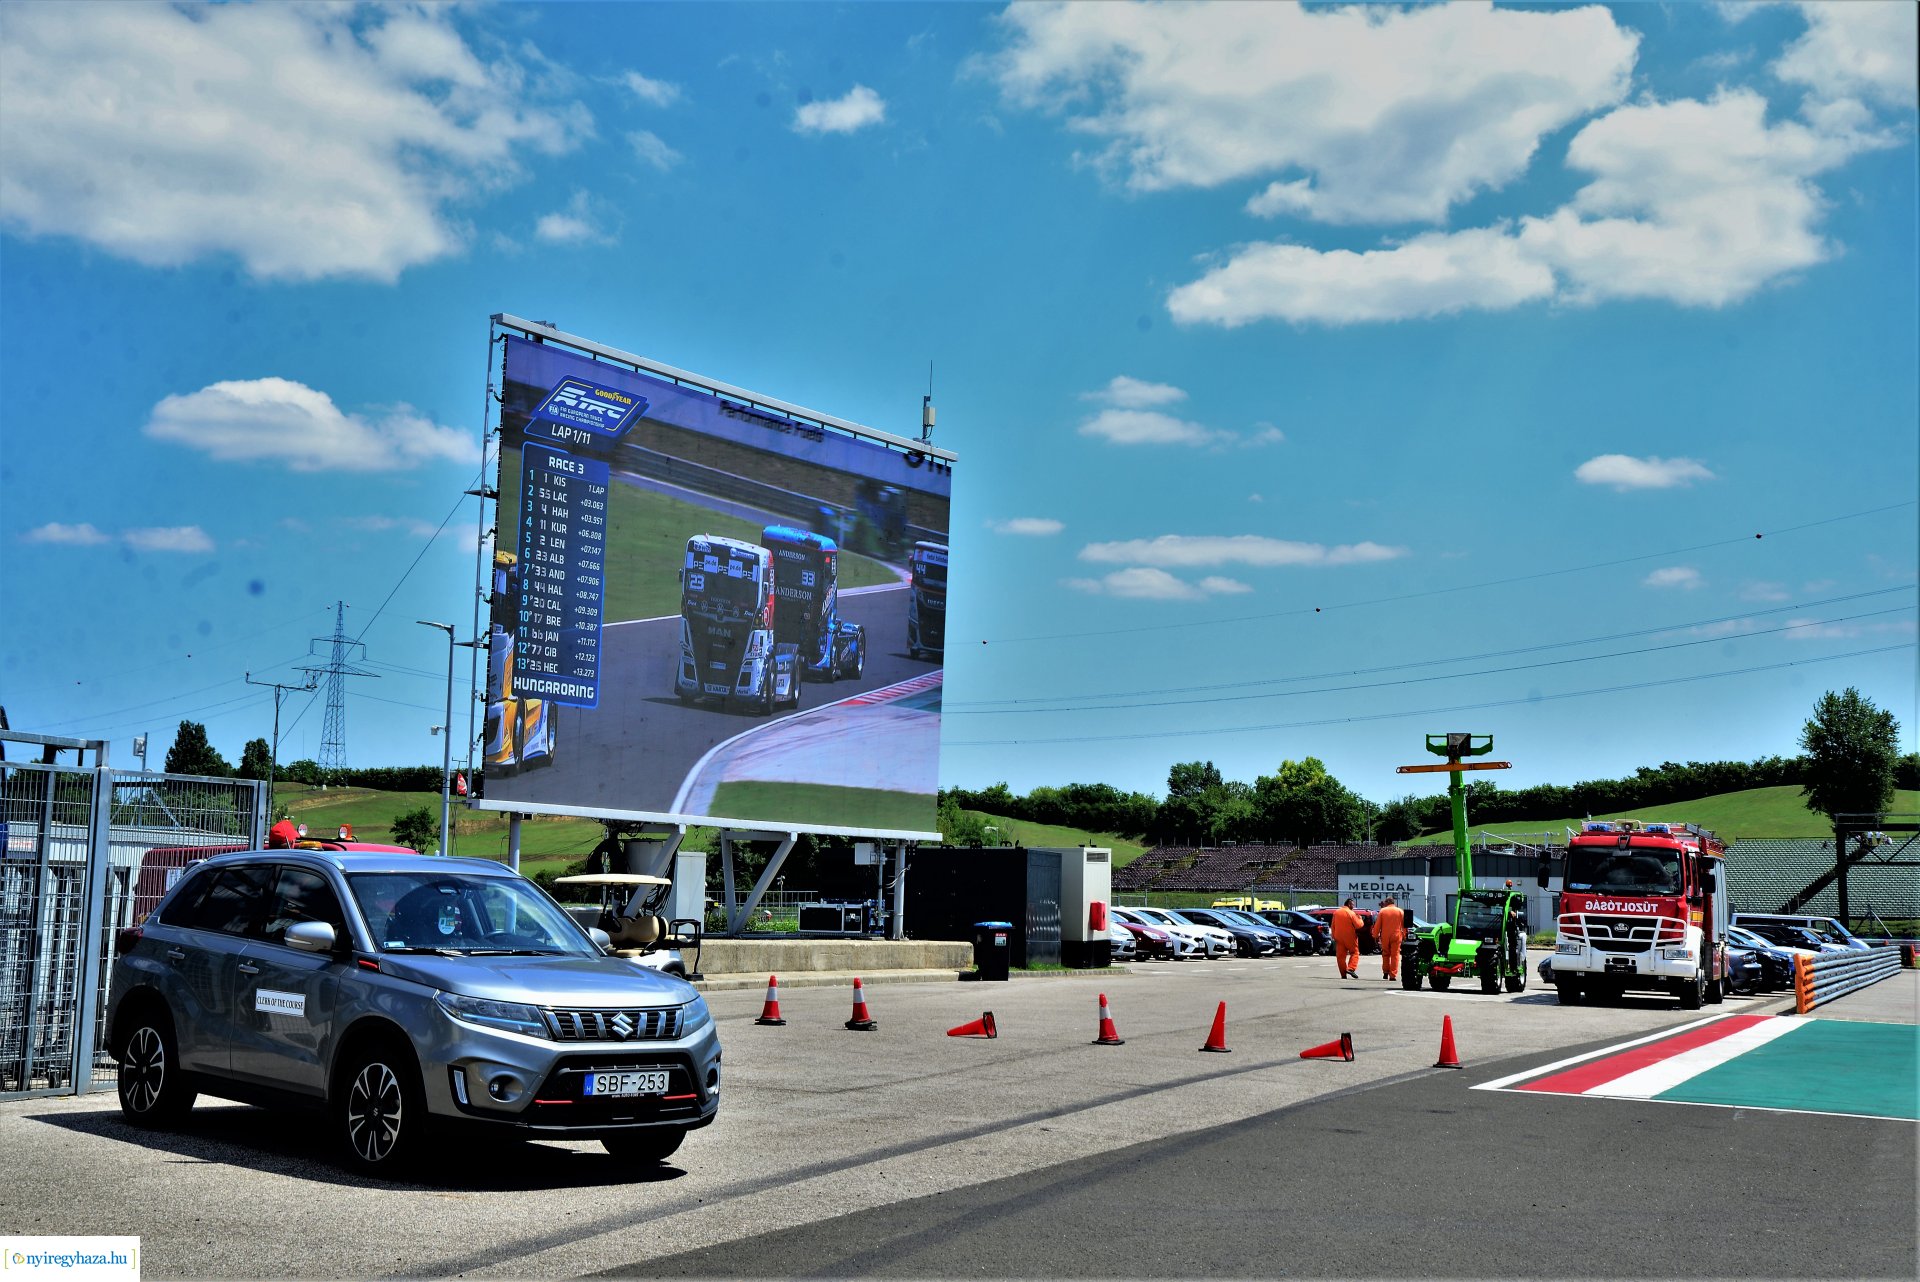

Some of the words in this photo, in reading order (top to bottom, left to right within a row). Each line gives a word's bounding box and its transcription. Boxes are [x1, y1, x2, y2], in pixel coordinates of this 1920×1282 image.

[554, 386, 626, 420] ETRC
[595, 389, 632, 404] GOODYEAR
[552, 424, 572, 438] LAP
[574, 430, 590, 444] 1/11
[549, 456, 574, 472] RACE
[578, 464, 584, 474] 3
[530, 470, 534, 480] 1
[544, 473, 548, 483] 1
[554, 476, 566, 487] KIS
[528, 485, 533, 496] 2
[539, 488, 550, 499] 55
[553, 491, 567, 503] LAC
[528, 501, 533, 511] 3
[542, 504, 547, 514] 4
[552, 506, 568, 518] HAH
[526, 516, 532, 527] 4
[540, 520, 546, 530] 11
[552, 522, 567, 534] KUR
[526, 532, 531, 543] 5
[540, 535, 545, 545] 2
[550, 538, 565, 549] LEN
[525, 548, 530, 558] 6
[536, 550, 547, 561] 23
[550, 553, 564, 564] ALB
[779, 550, 805, 560] ANDERSON
[524, 564, 529, 574] 7
[535, 566, 546, 577] 33
[549, 569, 565, 580] AND
[916, 563, 926, 575] 44
[690, 573, 704, 591] 23
[802, 570, 815, 587] 33
[523, 579, 528, 590] 8
[534, 581, 545, 593] 44
[548, 584, 563, 596] HAL
[776, 586, 812, 600] ANDERSON
[522, 595, 528, 606] 9
[533, 597, 545, 608] 20
[547, 600, 561, 611] CAL
[519, 611, 529, 622] 10
[534, 613, 542, 623] 17
[546, 615, 561, 626] BRE
[520, 626, 527, 638] 11
[545, 631, 559, 642] JAN
[709, 627, 731, 637] MAN
[518, 642, 527, 654] 12
[532, 644, 542, 655] 77
[544, 646, 557, 657] GIB
[517, 658, 526, 669] 13
[530, 660, 542, 671] 25
[544, 662, 558, 673] HEC
[514, 677, 594, 699] HUNGARORING
[1348, 882, 1414, 891] MEDICAL
[257, 996, 270, 1006] CLERK
[271, 998, 277, 1007] OF
[286, 1000, 303, 1010] COURSE
[596, 1074, 665, 1093] SBF-253
